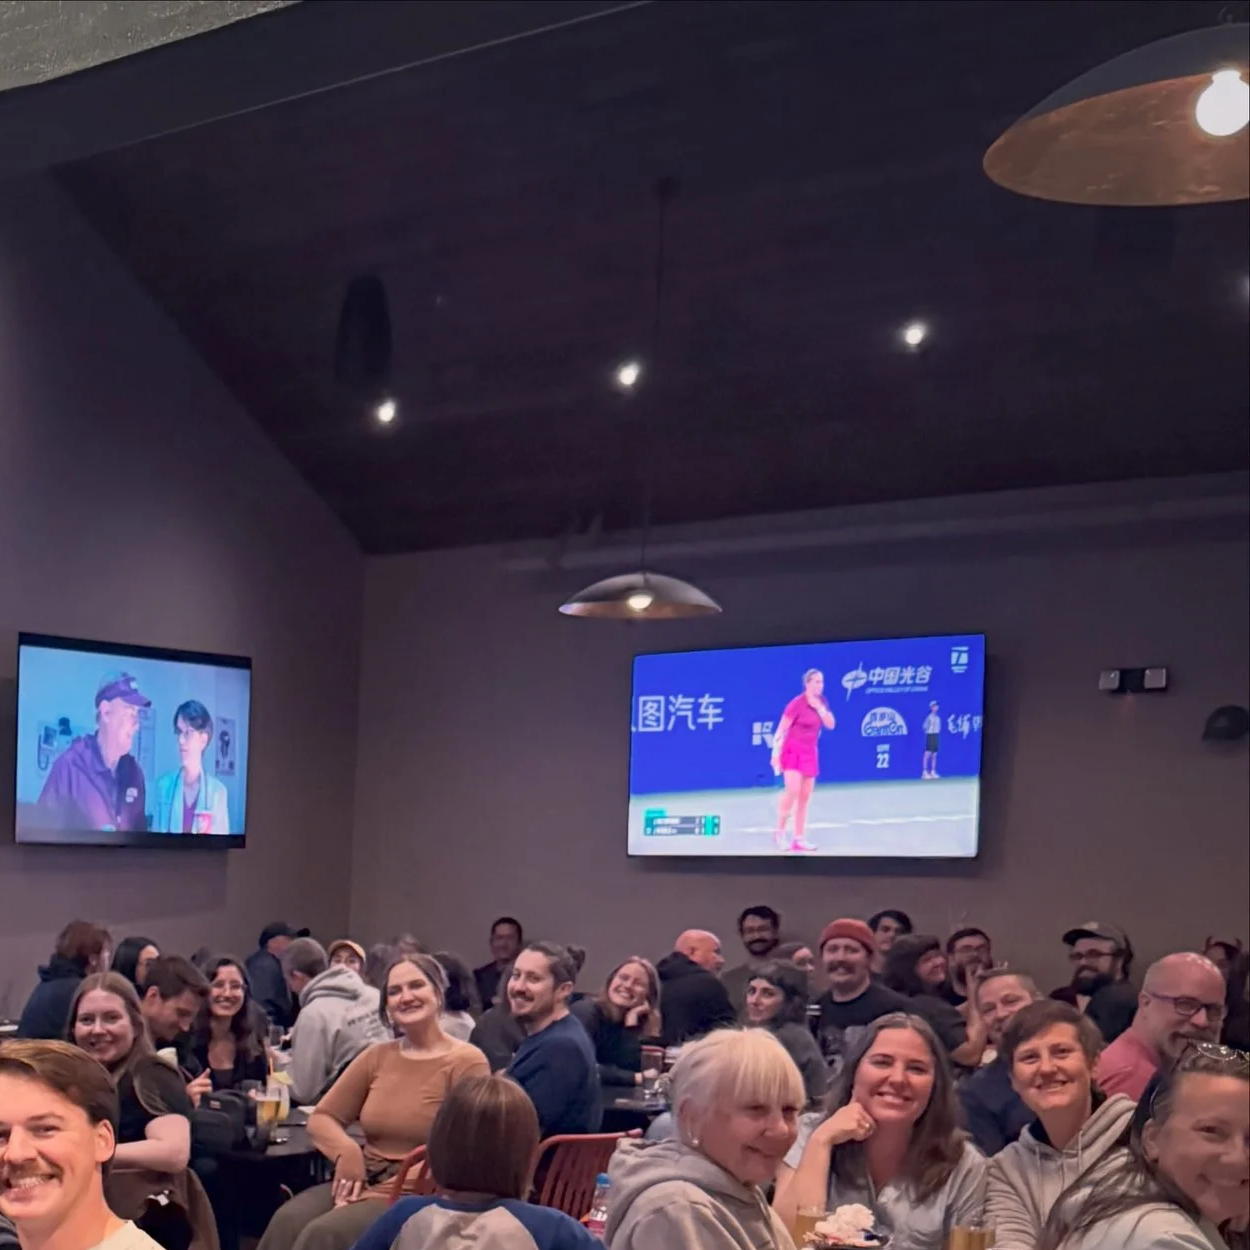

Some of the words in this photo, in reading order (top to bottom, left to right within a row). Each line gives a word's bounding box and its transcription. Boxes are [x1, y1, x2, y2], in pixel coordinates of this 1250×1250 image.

[868, 665, 933, 685] 中国光谷
[631, 693, 725, 731] 图汽车
[876, 753, 890, 769] 22
